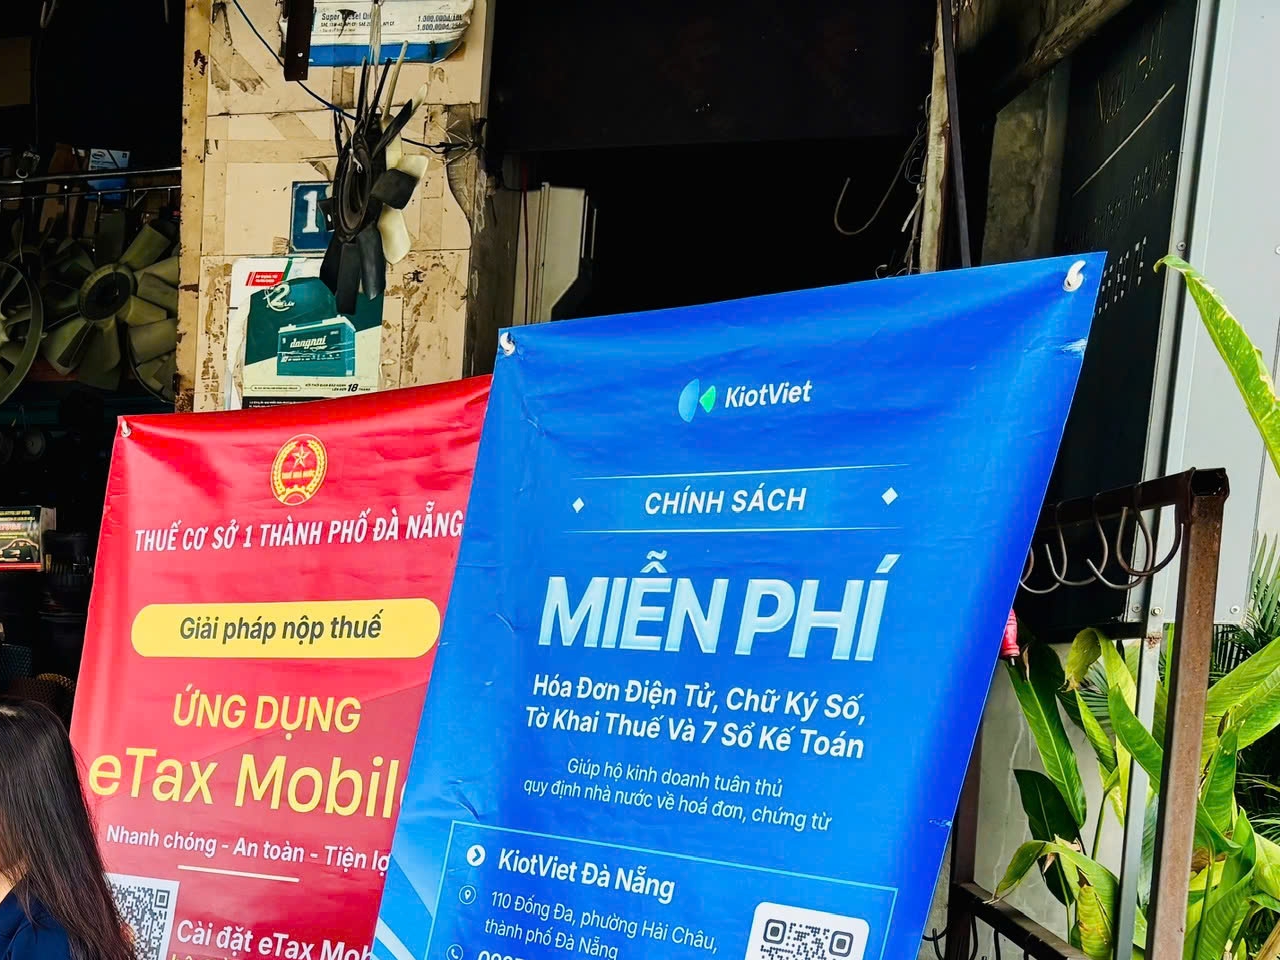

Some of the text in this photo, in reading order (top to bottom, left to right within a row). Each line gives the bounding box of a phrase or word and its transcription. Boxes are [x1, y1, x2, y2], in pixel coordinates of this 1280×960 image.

[322, 13, 340, 21] Super
[348, 384, 359, 392] 18
[725, 379, 812, 409] KiotViet
[644, 482, 807, 515] CHÍNH SÁCH
[180, 609, 384, 646] Giải pháp nộp thuế
[538, 549, 901, 662] MIỄN PHÍ
[173, 683, 361, 741] ỨNG DỤNG
[533, 674, 867, 726] Hóa Đơn Điện Tử, Chữ Ký Số,
[525, 706, 865, 760] Tờ Khai Thuế Và 7 Sổ Kế Toán
[88, 747, 406, 819] eTax Mobil
[524, 778, 832, 832] quy định nhà nước về hoá đơn, chứng từ
[106, 824, 367, 875] Nhanh chóng An toàn Tiện
[498, 848, 675, 904] KiotViet Đà Nẵng
[176, 919, 212, 945] Cài
[216, 926, 252, 954] đặt
[491, 891, 718, 954] 110 Đống Đa, phường Hải Châu,
